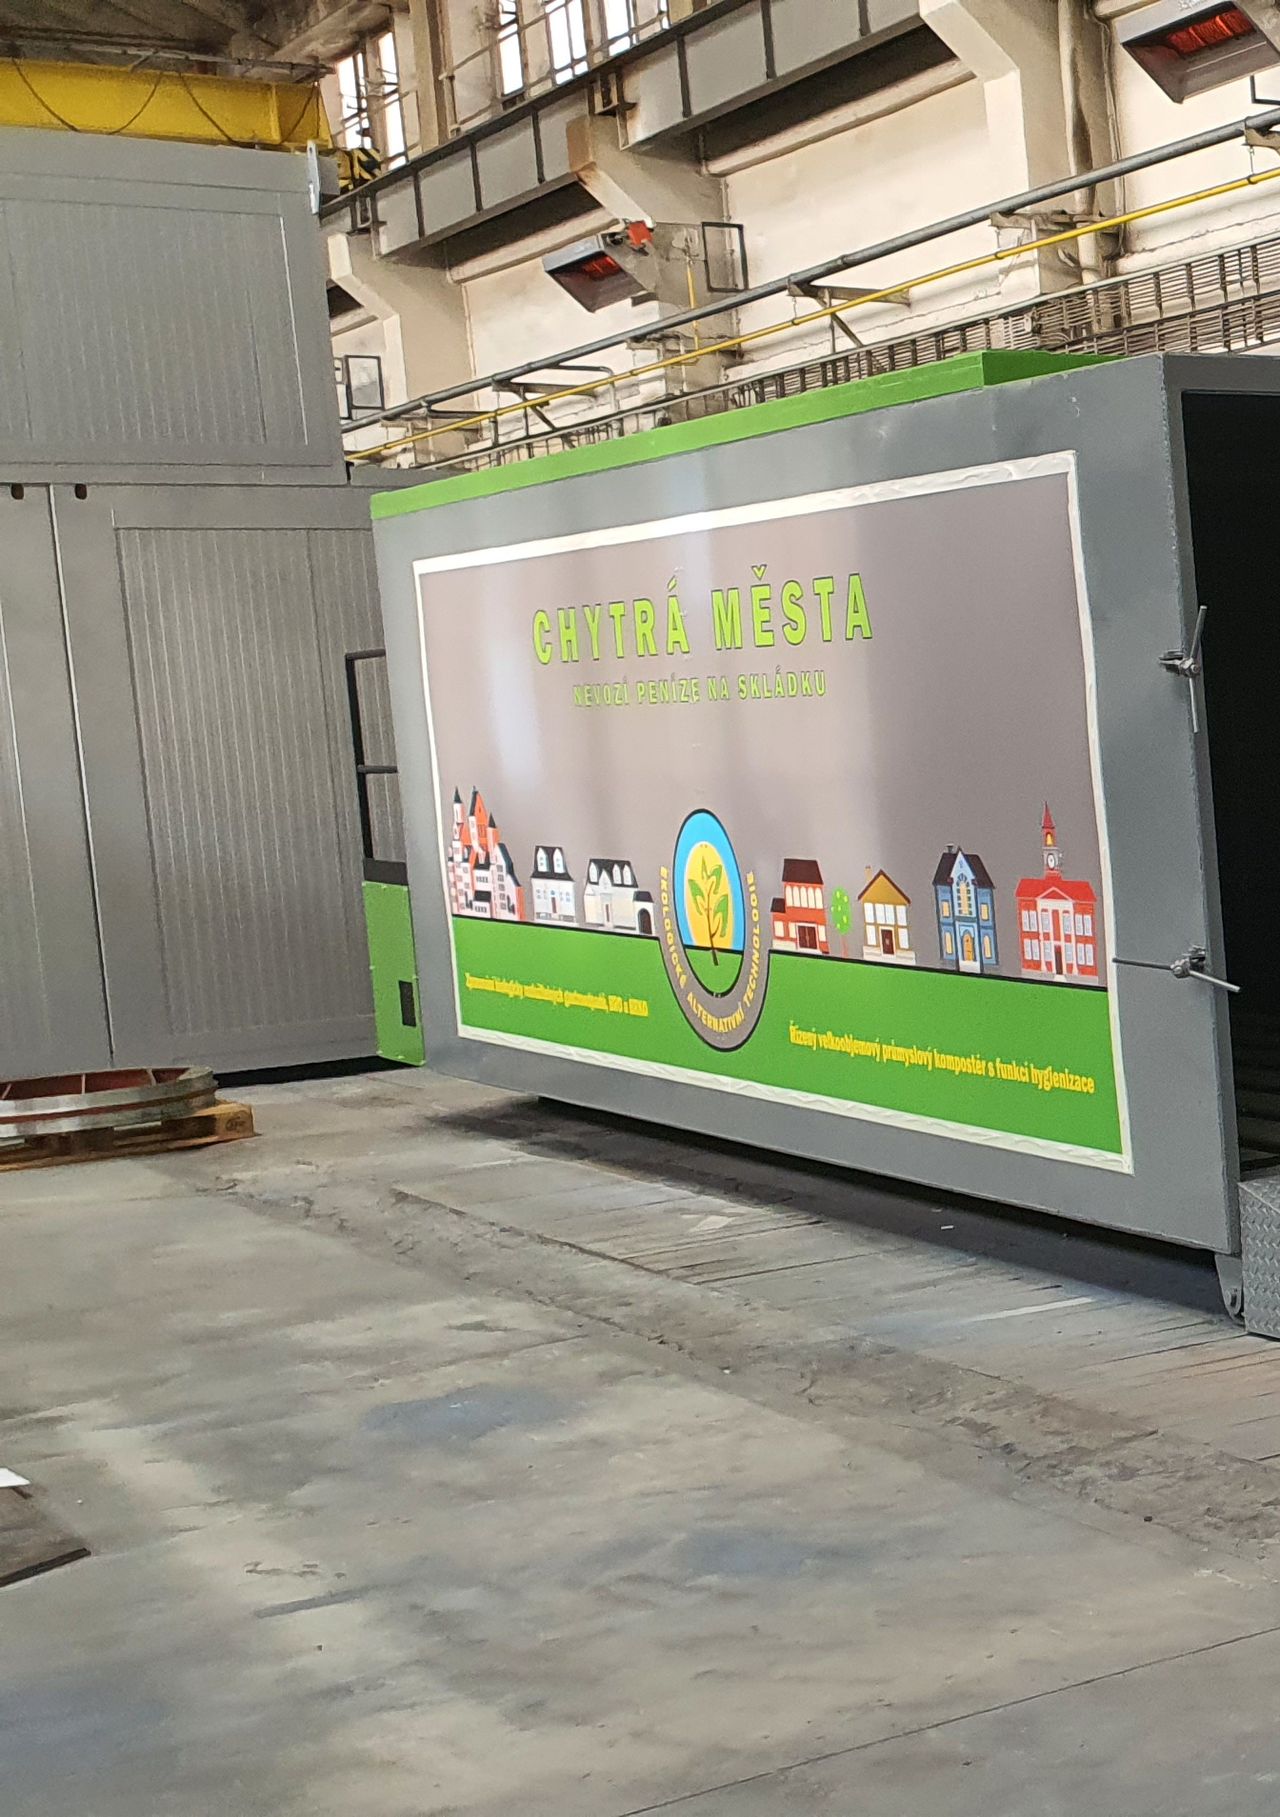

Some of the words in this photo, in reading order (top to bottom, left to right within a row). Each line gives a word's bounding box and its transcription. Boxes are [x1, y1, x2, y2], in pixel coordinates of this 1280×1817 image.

[532, 575, 690, 665] CHYTRÁ
[711, 564, 873, 650] MĚSTA
[572, 676, 630, 707] NEVOZÍ
[636, 672, 700, 705] PENÍZE
[706, 675, 730, 701] NA
[737, 664, 827, 700] SKLÁDKU
[1030, 1063, 1096, 1094] hygienizace
